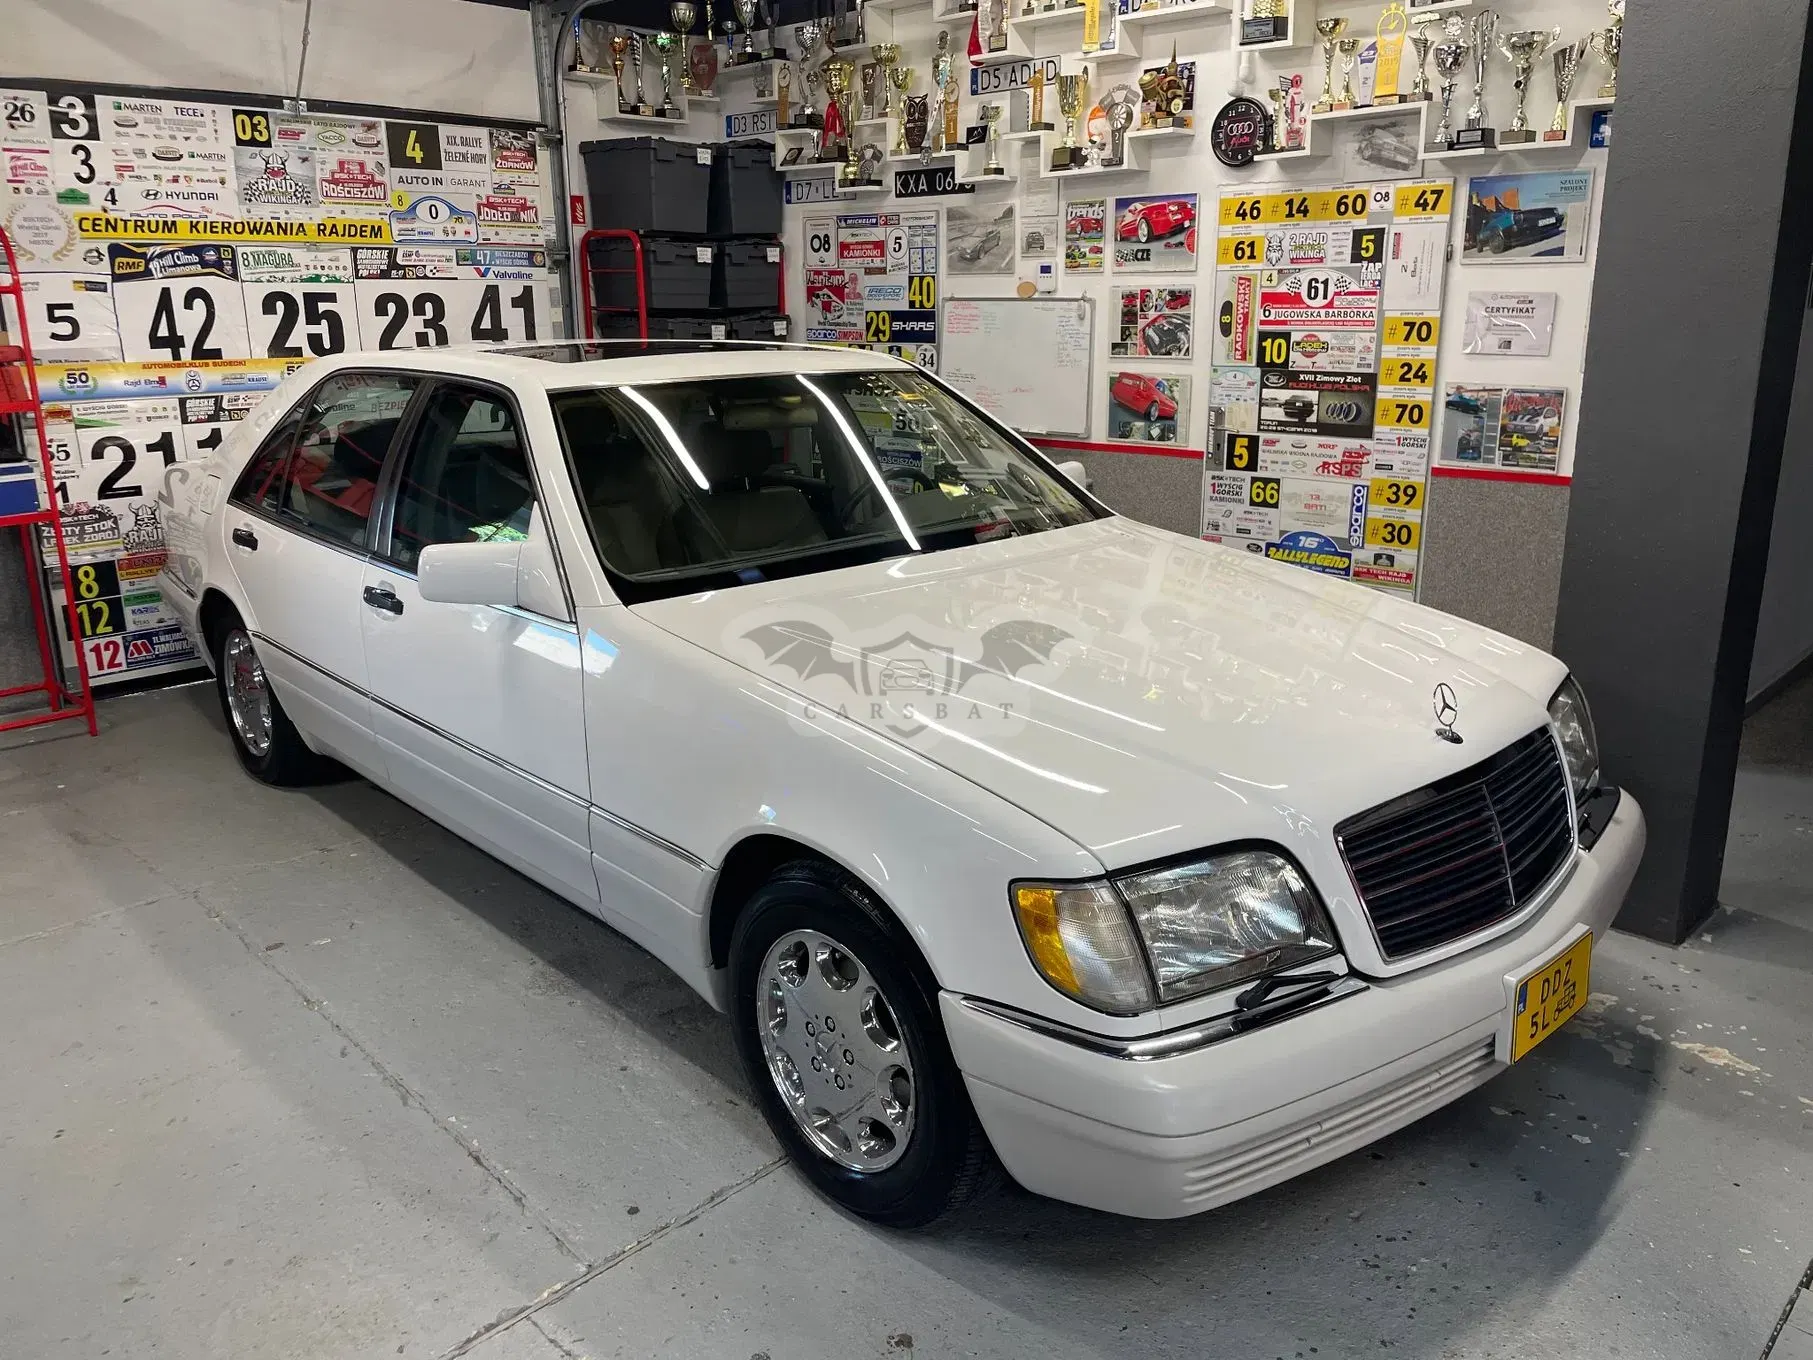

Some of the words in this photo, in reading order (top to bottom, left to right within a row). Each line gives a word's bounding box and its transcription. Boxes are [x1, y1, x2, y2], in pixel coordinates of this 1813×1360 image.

[981, 70, 1000, 90] D5
[4, 101, 35, 122] 26
[123, 103, 162, 113] MARTEN
[174, 106, 200, 117] TECE
[58, 96, 90, 138] 3
[733, 117, 747, 132] D3
[235, 114, 269, 142] 03
[406, 130, 424, 164] 4
[446, 135, 459, 146] XIX.
[460, 136, 482, 148] RALLYE
[71, 144, 95, 184] 3
[196, 152, 226, 160] MARTEN
[470, 152, 487, 164] HORY
[258, 179, 296, 192] RAJD
[398, 175, 430, 185] AUTO
[432, 176, 443, 186] IN
[450, 178, 486, 188] GARANT
[897, 172, 928, 194] KXA
[104, 187, 118, 205] 4
[166, 191, 218, 200] HYUNDAI
[322, 182, 385, 199] ROŚCISZÓW
[796, 182, 812, 200] D7
[259, 194, 298, 204] WIKINGA
[397, 195, 404, 206] 8
[1067, 204, 1104, 217] trends
[78, 217, 177, 234] CENTRUM
[189, 218, 307, 237] KIEROWANIA
[317, 223, 383, 238] RAJDEM
[893, 236, 902, 253] 5
[1290, 234, 1297, 245] 2
[1299, 233, 1328, 245] RAJD
[1361, 235, 1375, 258] 5
[843, 249, 880, 257] KAMIONKI
[1289, 250, 1325, 259] WIKINGA
[117, 261, 143, 270] RMF
[149, 259, 162, 279] 12
[160, 253, 174, 266] Hill
[174, 252, 199, 264] Climb
[162, 264, 202, 275] Limanowa
[493, 270, 533, 279] Valvoline
[1266, 273, 1272, 283] 4
[909, 276, 935, 308] 40
[1307, 278, 1329, 300] 61
[471, 285, 537, 342] 41
[1263, 304, 1271, 318] 6
[1274, 311, 1321, 319] JUGOWSKA
[1325, 309, 1374, 318] BARBÓRKA
[1485, 306, 1536, 314] CERTYFIKAT
[46, 303, 80, 341] 5
[149, 287, 223, 361] 42
[262, 291, 345, 358] 25
[374, 292, 448, 351] 23
[866, 311, 890, 341] 29
[1222, 315, 1231, 323] 8
[1235, 280, 1245, 359] RADKOWSKI
[807, 330, 836, 339] sparco
[838, 331, 863, 340] SIMPSON
[1262, 338, 1286, 363] 10
[142, 361, 209, 370] AUTOMOBILKLUB
[212, 360, 246, 368] SUDECKI
[919, 353, 935, 367] 34
[67, 372, 89, 384] 50
[124, 379, 142, 387] Rajd
[1316, 375, 1345, 384] Zimowy
[1396, 436, 1401, 446] 1
[1233, 437, 1249, 468] 5
[91, 431, 176, 500] 21
[1211, 483, 1216, 494] 1
[1217, 482, 1243, 490] WYŚCIG
[1217, 488, 1242, 496] GÓRSKI
[1251, 481, 1278, 504] 66
[1210, 496, 1244, 504] KAMIONKI
[1350, 486, 1367, 546] sparco
[84, 519, 116, 532] STOK
[1268, 547, 1350, 569] RALLYLEGEND
[78, 565, 99, 599] 8
[76, 601, 113, 636] 12
[89, 640, 122, 671] 12
[1540, 958, 1572, 1005] DDZ
[1530, 1006, 1550, 1039] 5L
